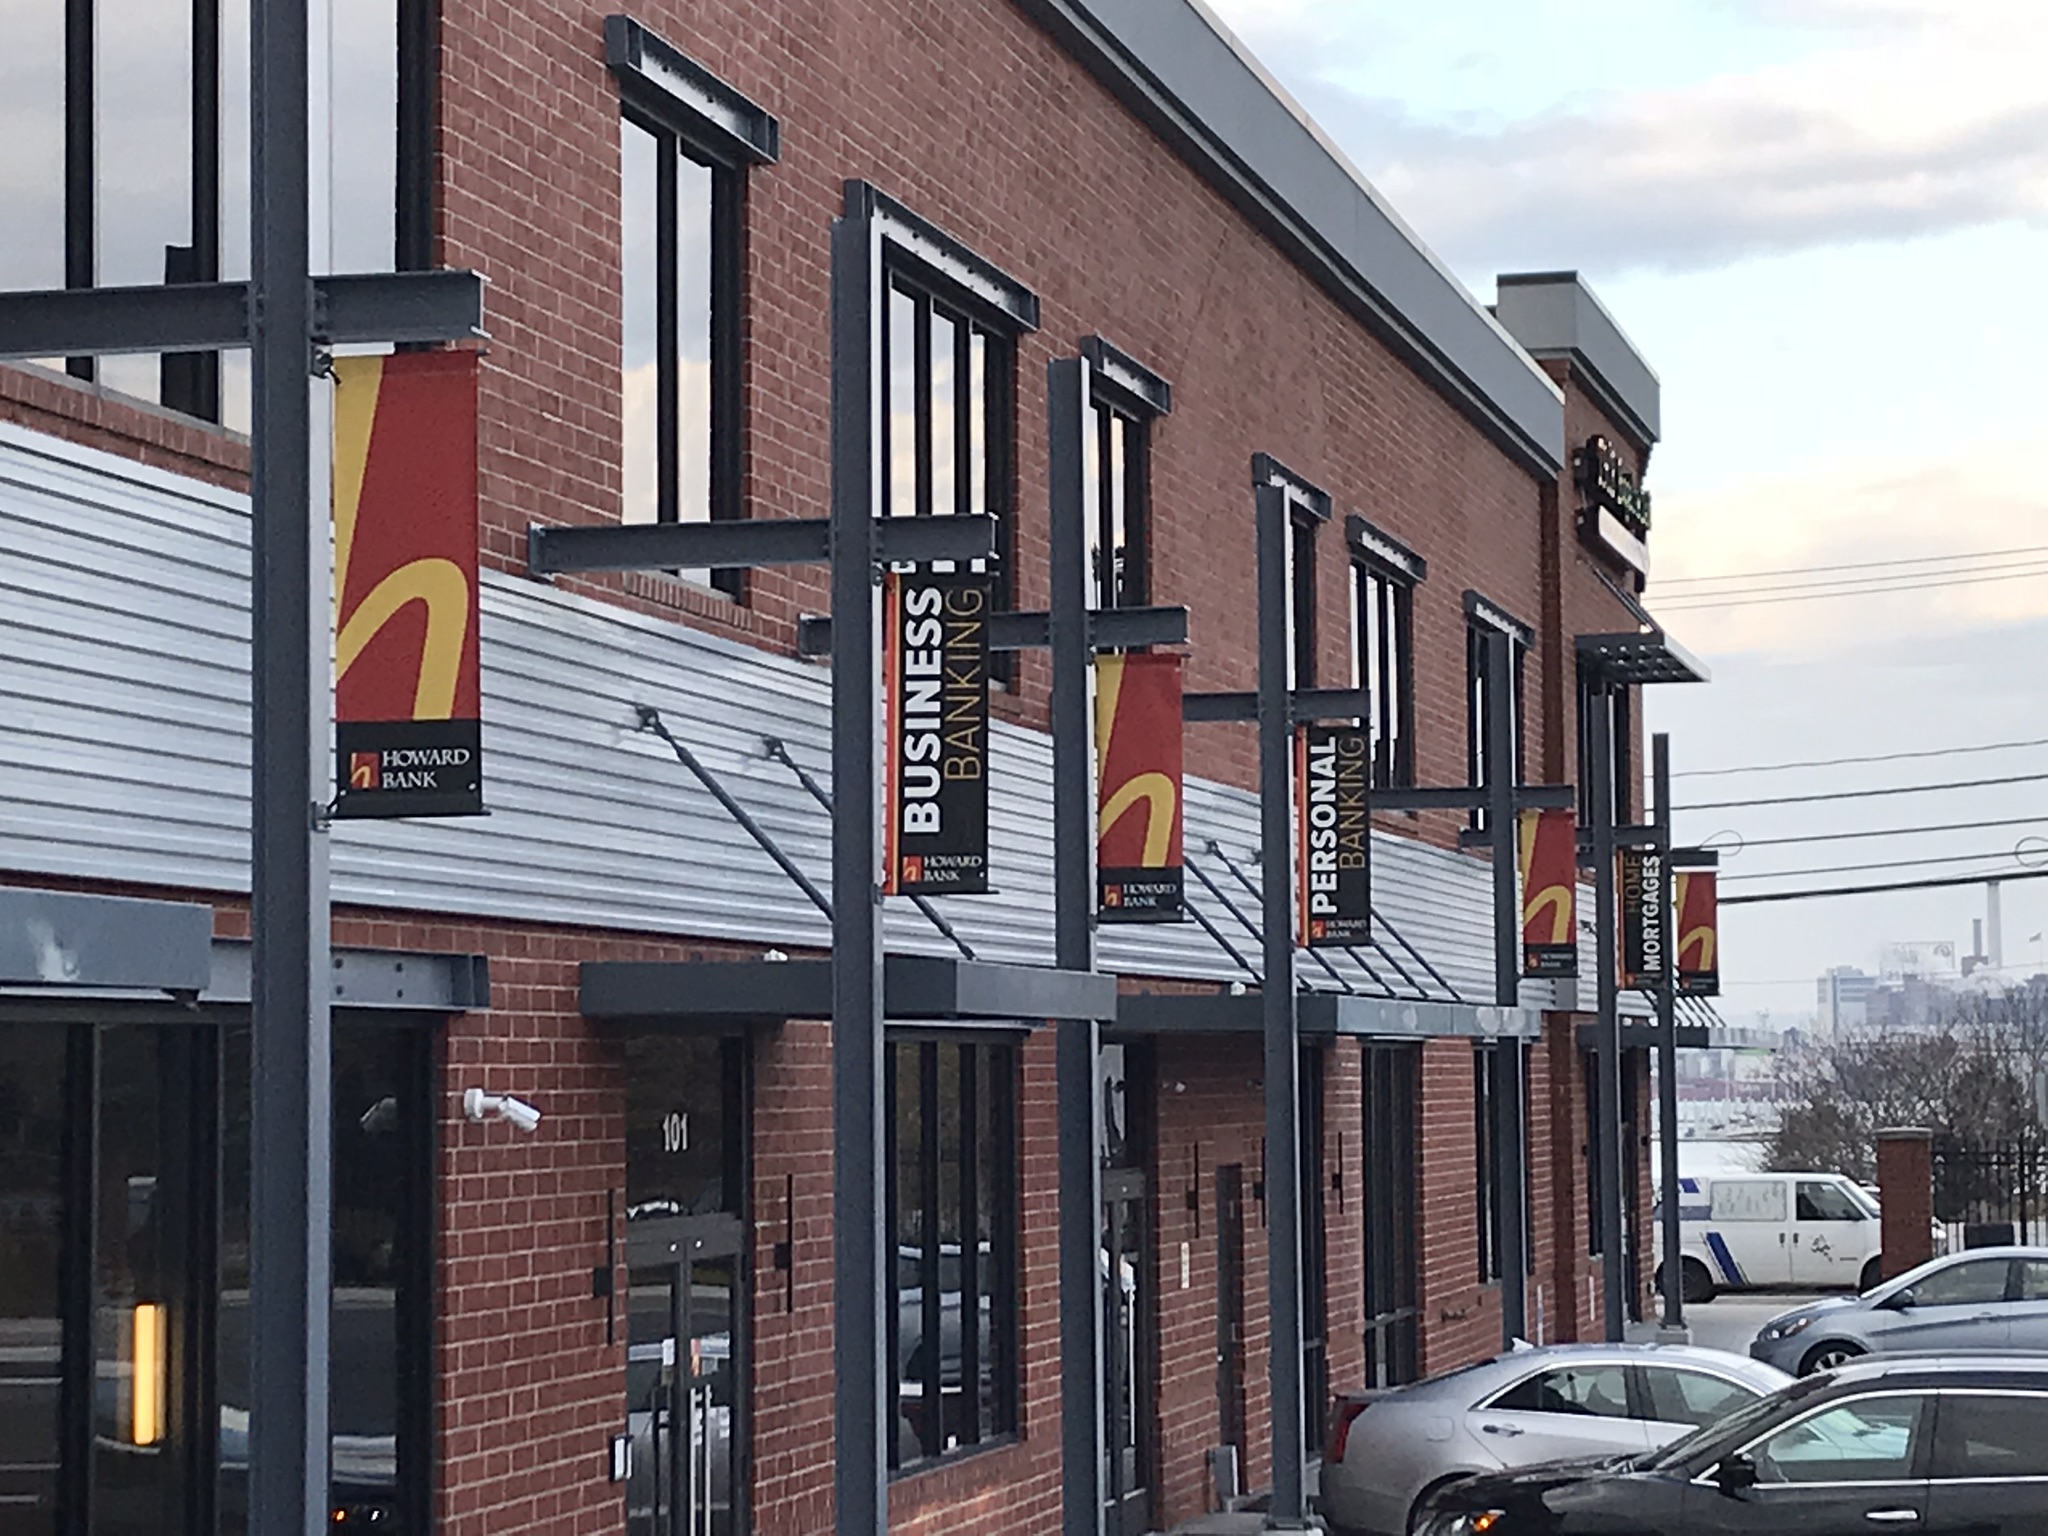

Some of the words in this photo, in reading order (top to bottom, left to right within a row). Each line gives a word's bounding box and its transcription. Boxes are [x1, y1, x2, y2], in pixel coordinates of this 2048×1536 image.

[903, 586, 943, 834] BUSINESS
[944, 587, 984, 780] BANKING
[381, 748, 471, 767] HOWARD
[381, 771, 438, 789] BANK
[1310, 736, 1338, 914] PERSONAL
[1338, 737, 1366, 869] BANKING
[923, 855, 983, 868] HOWARD
[923, 869, 961, 882] BANK
[1641, 855, 1662, 971] MORTGAGES
[662, 1112, 688, 1152] 101
